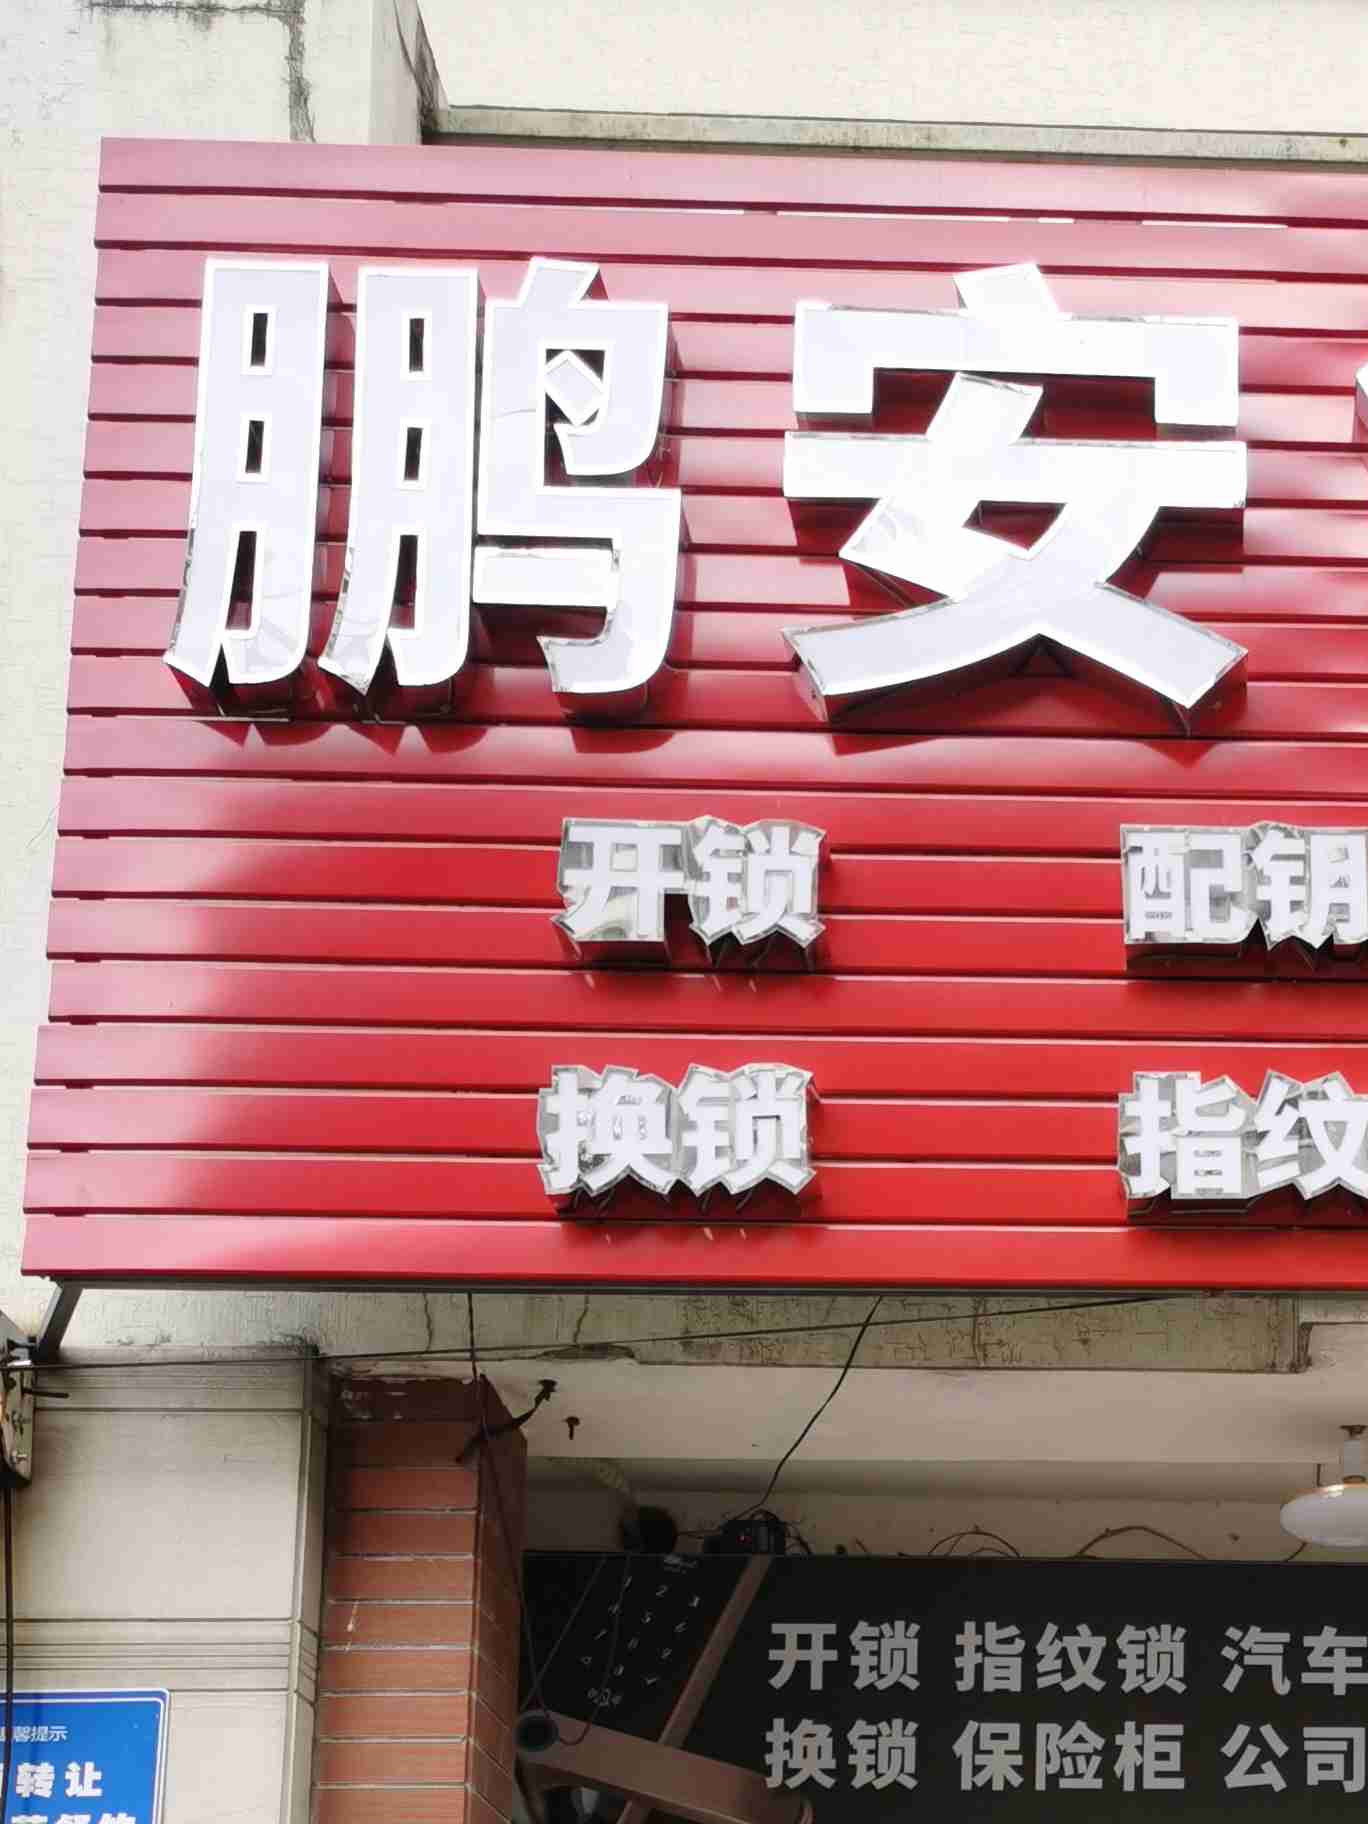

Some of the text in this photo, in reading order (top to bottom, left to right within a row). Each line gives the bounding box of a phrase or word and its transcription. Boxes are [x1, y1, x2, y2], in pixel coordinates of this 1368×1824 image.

[555, 816, 825, 943] 开锁
[539, 1063, 813, 1196] 换锁
[768, 1621, 920, 1693] 开锁
[955, 1622, 1188, 1695] 指纹锁
[0, 1725, 69, 1743] 馨提示
[764, 1718, 919, 1791] 换锁
[952, 1719, 1187, 1792] 保险柜
[0, 1761, 103, 1799] 转让
